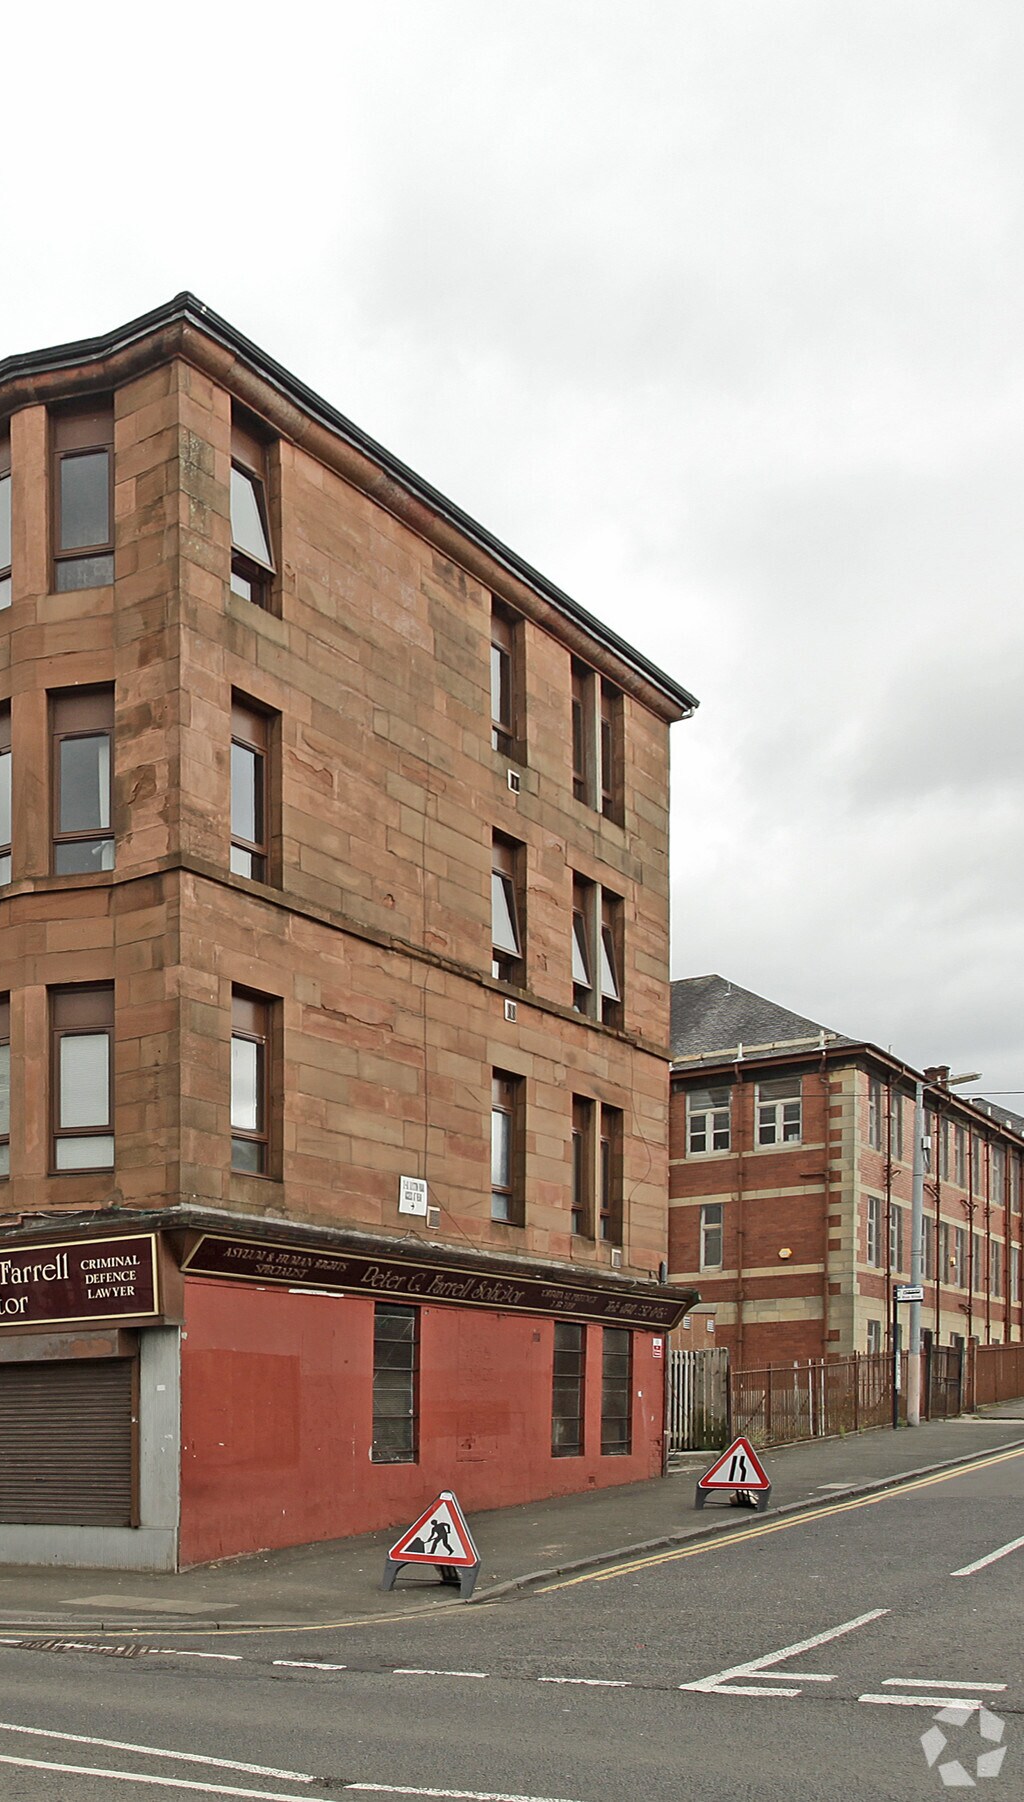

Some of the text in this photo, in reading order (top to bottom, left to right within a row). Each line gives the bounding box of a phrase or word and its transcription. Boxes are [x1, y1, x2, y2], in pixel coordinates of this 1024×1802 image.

[0, 1253, 69, 1286] Farrell
[80, 1255, 140, 1270] CRIMINAL
[85, 1270, 137, 1285] DEFENCE
[361, 1266, 406, 1289] Peter
[426, 1274, 475, 1297] Farrell
[471, 1281, 525, 1304] Solicitor
[87, 1285, 135, 1299] LAWYER
